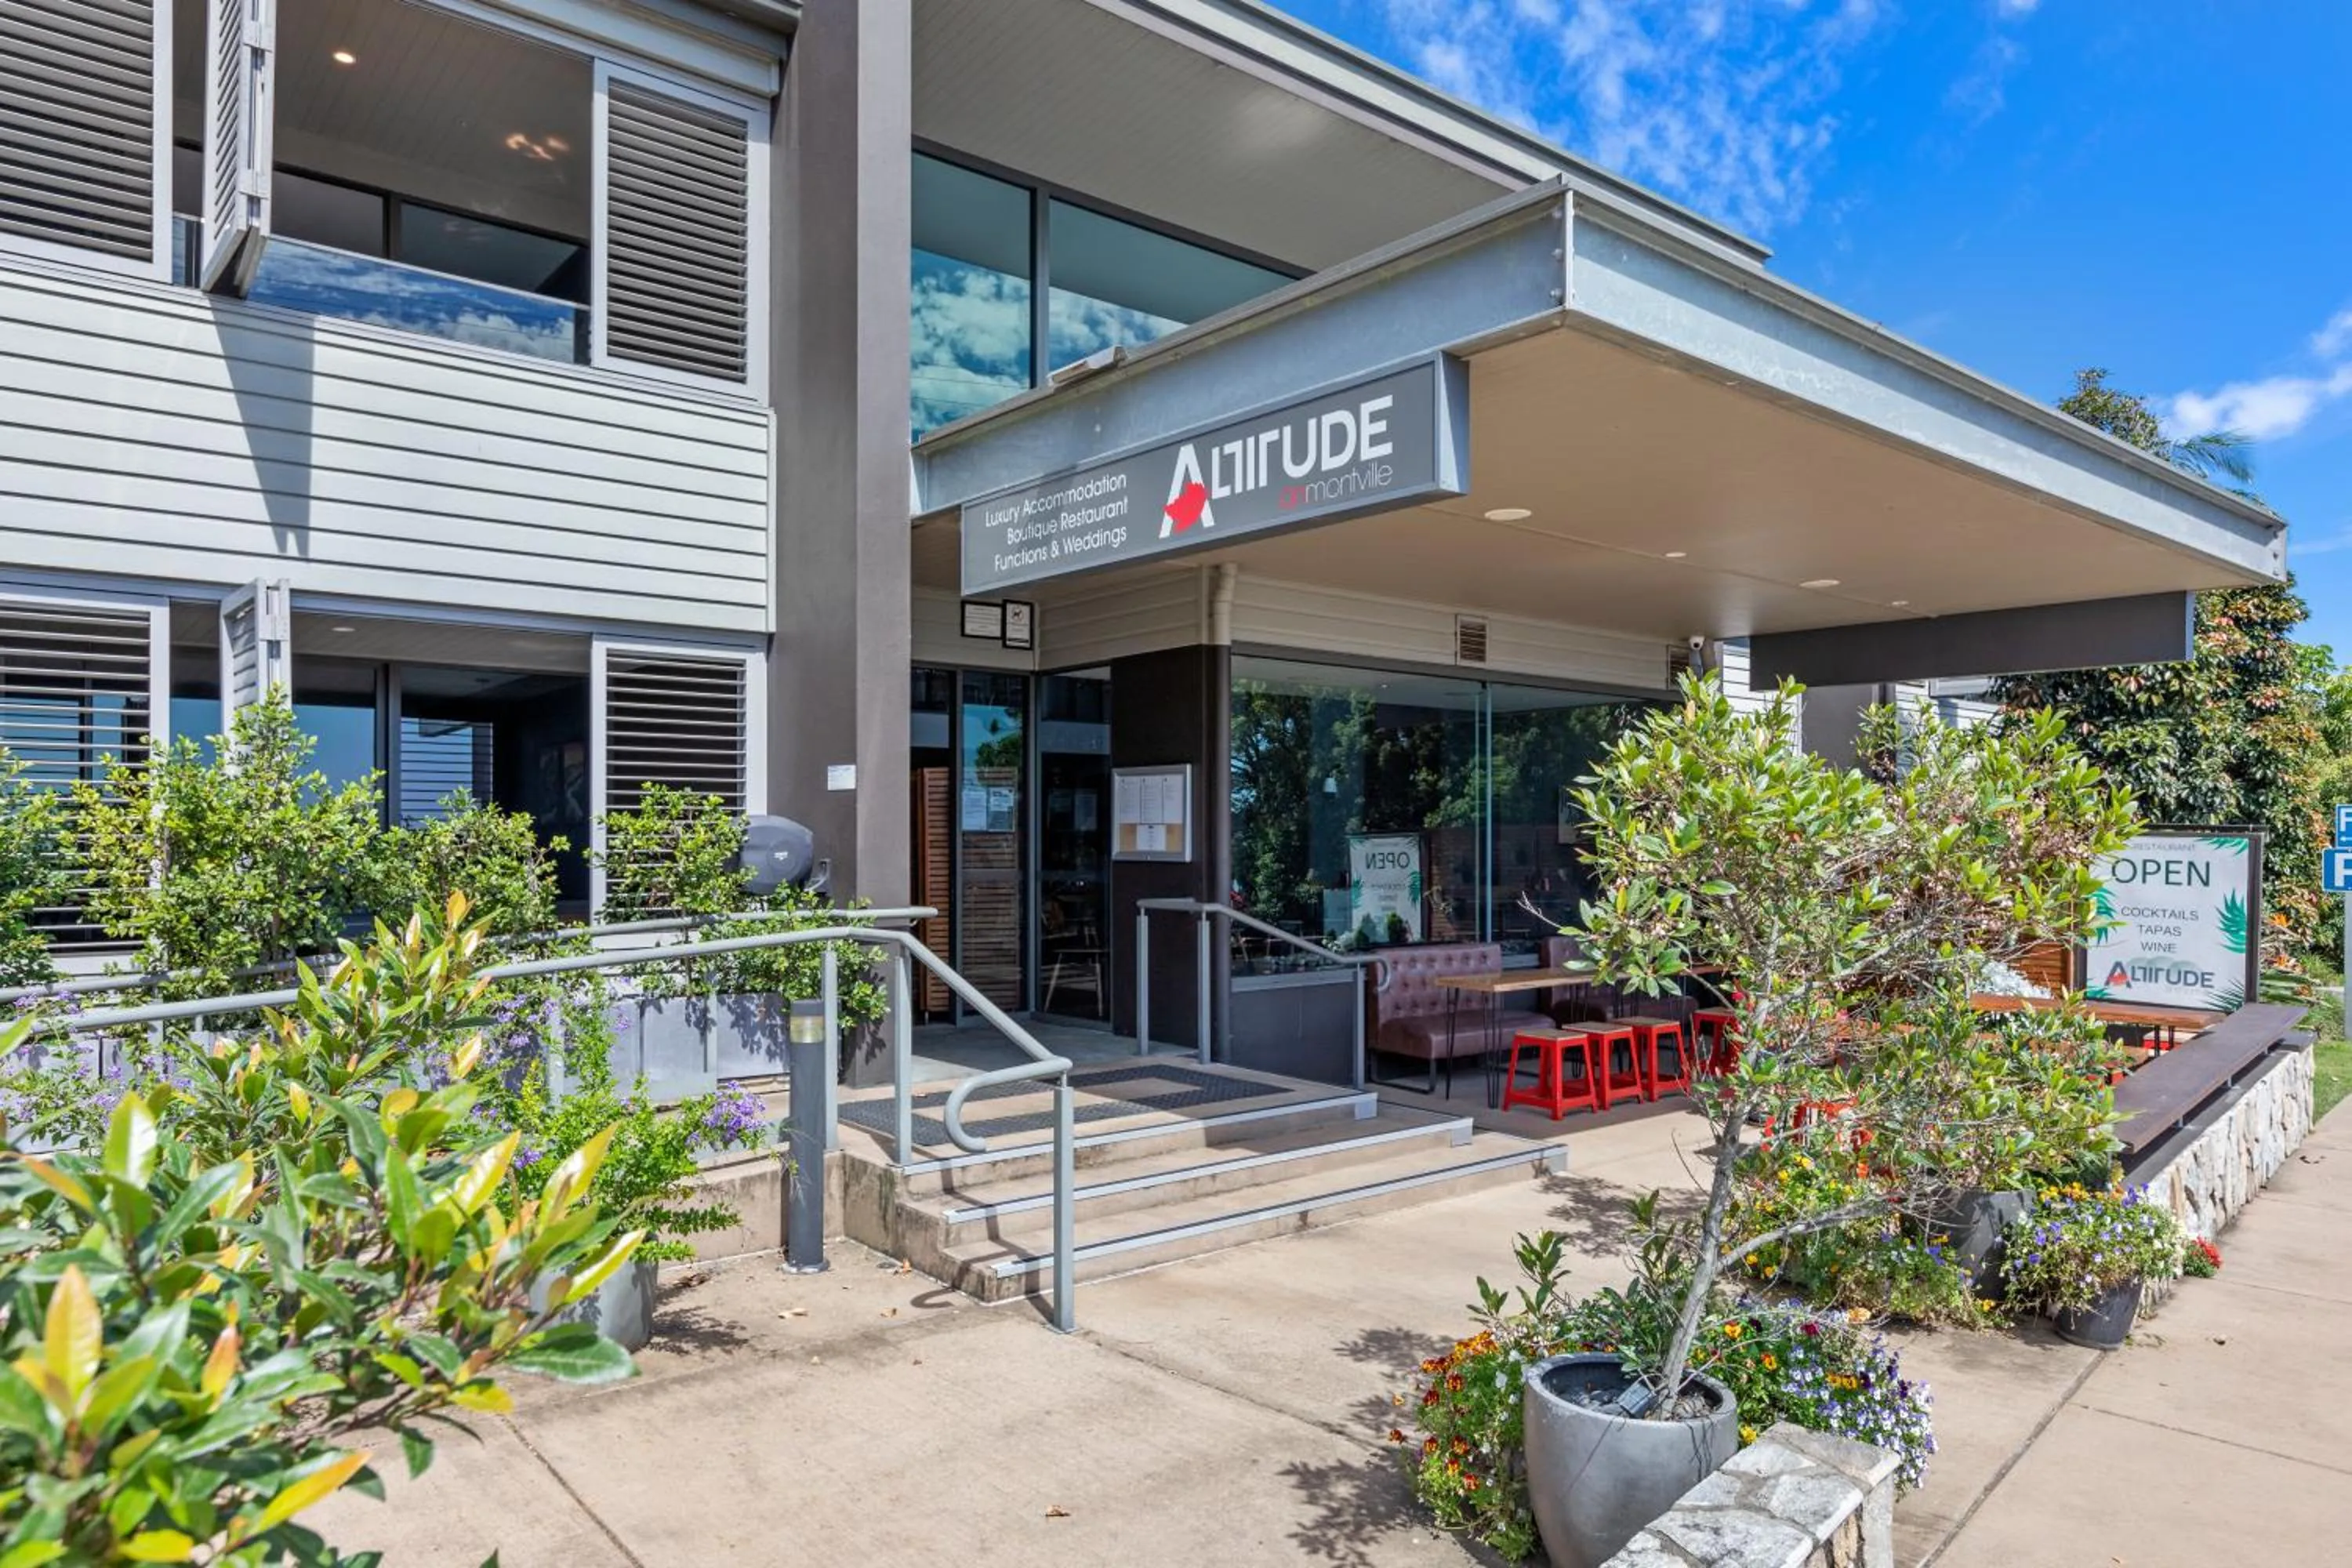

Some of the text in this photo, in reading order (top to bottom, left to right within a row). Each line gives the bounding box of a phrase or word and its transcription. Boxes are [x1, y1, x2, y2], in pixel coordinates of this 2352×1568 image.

[1306, 461, 1393, 503] montville
[985, 474, 1127, 528] Luxury Accommodation
[1007, 495, 1129, 546] Boutique Restaurant
[995, 525, 1127, 572] Functions & Weddings
[2111, 858, 2210, 887] OPEN
[2121, 906, 2199, 921] COCKTAILS
[2138, 924, 2182, 937] TAPAS
[2140, 941, 2177, 953] WINE
[2104, 961, 2216, 989] ALTITUDE
